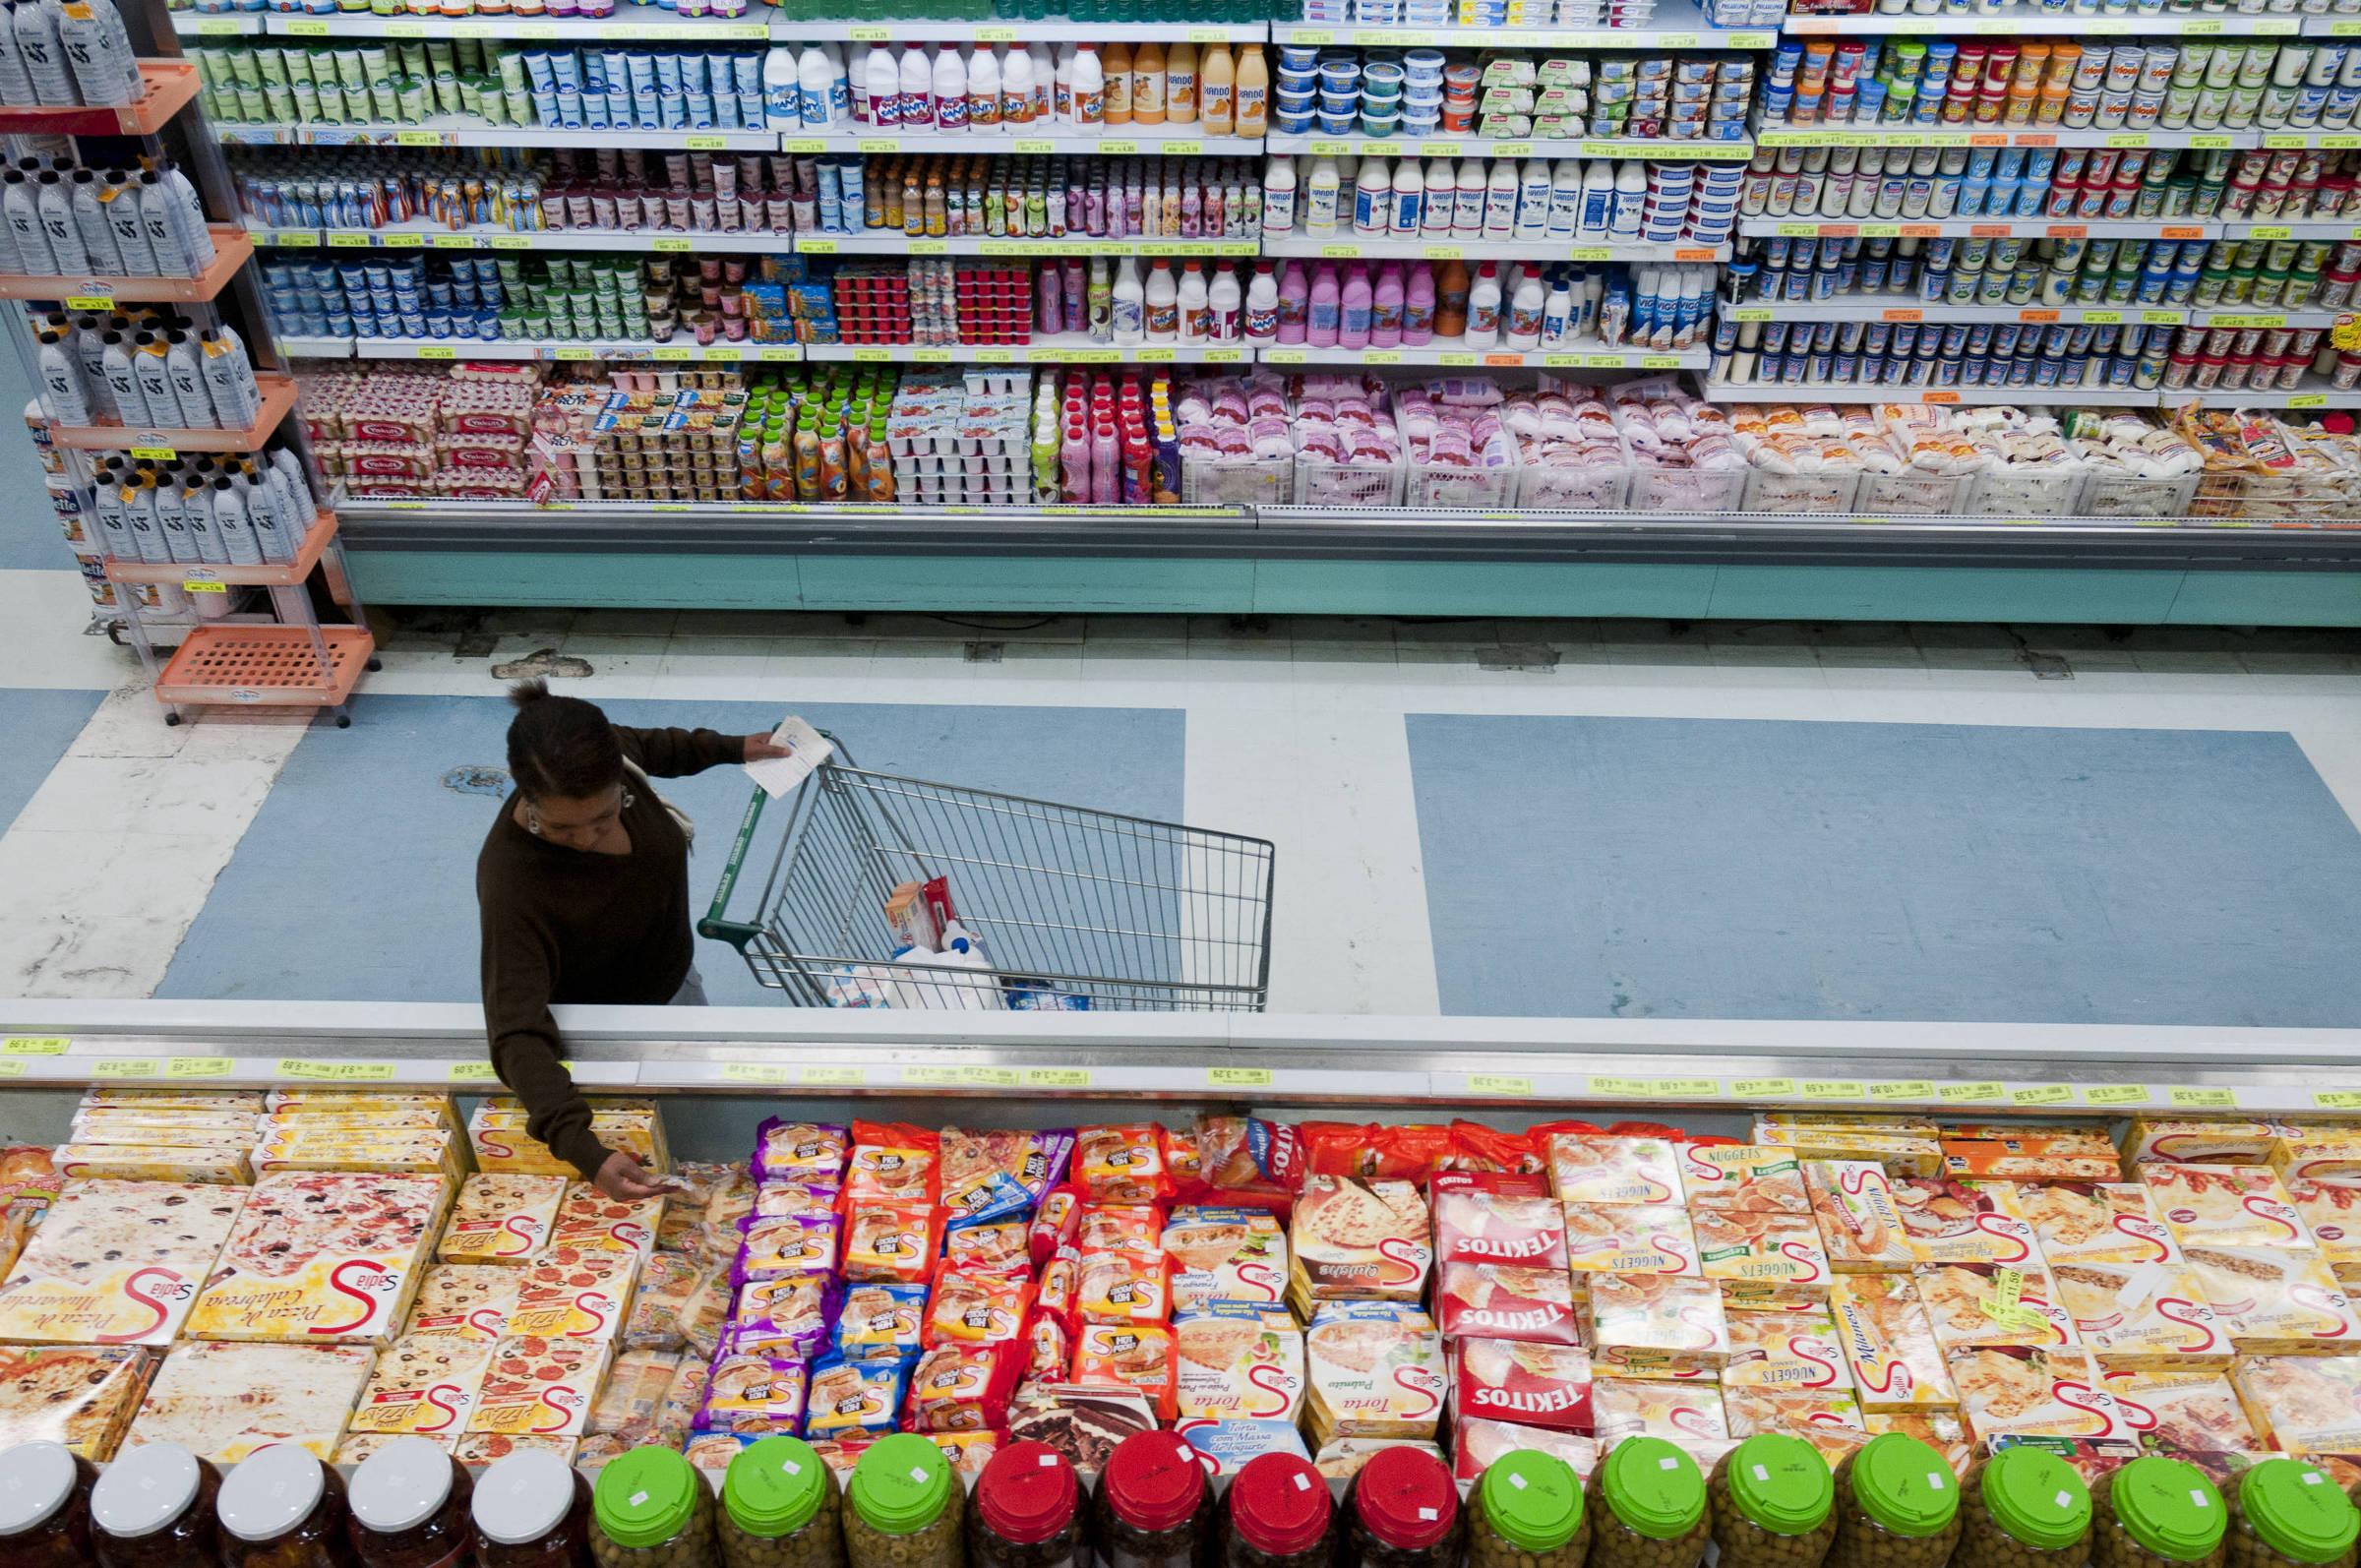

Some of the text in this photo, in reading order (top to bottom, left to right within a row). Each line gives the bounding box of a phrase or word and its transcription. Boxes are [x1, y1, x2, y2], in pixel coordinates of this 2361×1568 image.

[1709, 1148, 1761, 1163] NUGGETS
[1867, 1186, 1898, 1232] NUGGETS
[1456, 1231, 1557, 1259] TEKITOS
[1611, 1255, 1665, 1269] NUGGETS
[1740, 1262, 1797, 1277] NUGGETS
[151, 1283, 194, 1300] Sadia
[356, 1275, 397, 1292] Sadia
[204, 1289, 303, 1311] Calabresa
[32, 1313, 116, 1331] Pizza de
[239, 1304, 324, 1328] Pizza de
[1460, 1303, 1565, 1330] TEKITOS
[1846, 1303, 1878, 1365] Milanesa
[1268, 1375, 1297, 1389] Sadia
[1413, 1375, 1443, 1388] Sadia
[1762, 1366, 1816, 1383] NUGGETS
[1328, 1379, 1373, 1391] Palmito
[1193, 1395, 1241, 1411] Torta
[1342, 1398, 1389, 1413] Torta
[1475, 1384, 1584, 1413] TEKITOS
[360, 1404, 424, 1423] PIZZAS
[474, 1405, 540, 1424] PIZZAS
[1228, 1422, 1257, 1433] Torta
[1210, 1431, 1272, 1443] com Massa
[1211, 1442, 1227, 1452] de
